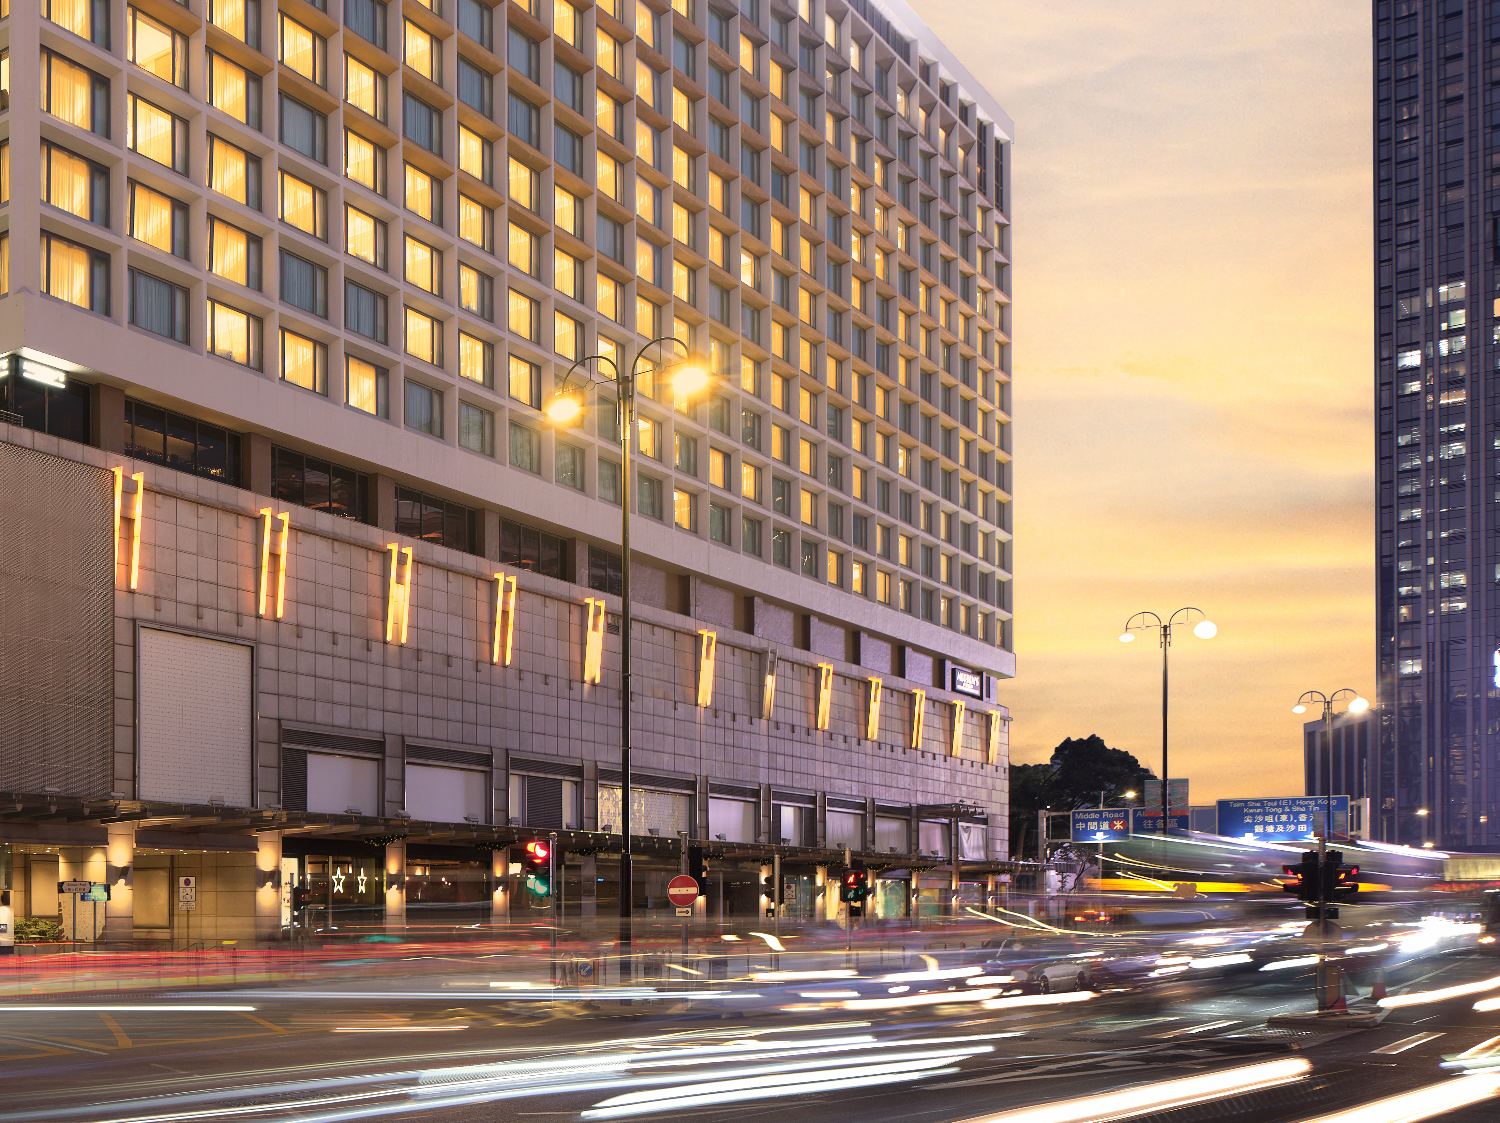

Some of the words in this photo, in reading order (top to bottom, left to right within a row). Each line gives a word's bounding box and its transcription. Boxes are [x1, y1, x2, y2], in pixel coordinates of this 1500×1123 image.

[1296, 799, 1315, 807] Hong
[1317, 798, 1337, 806] Kog
[1075, 812, 1100, 820] Middle
[1102, 811, 1124, 819] Road
[1075, 821, 1110, 831] 中間道
[1254, 824, 1307, 833] 觀塘及沙田
